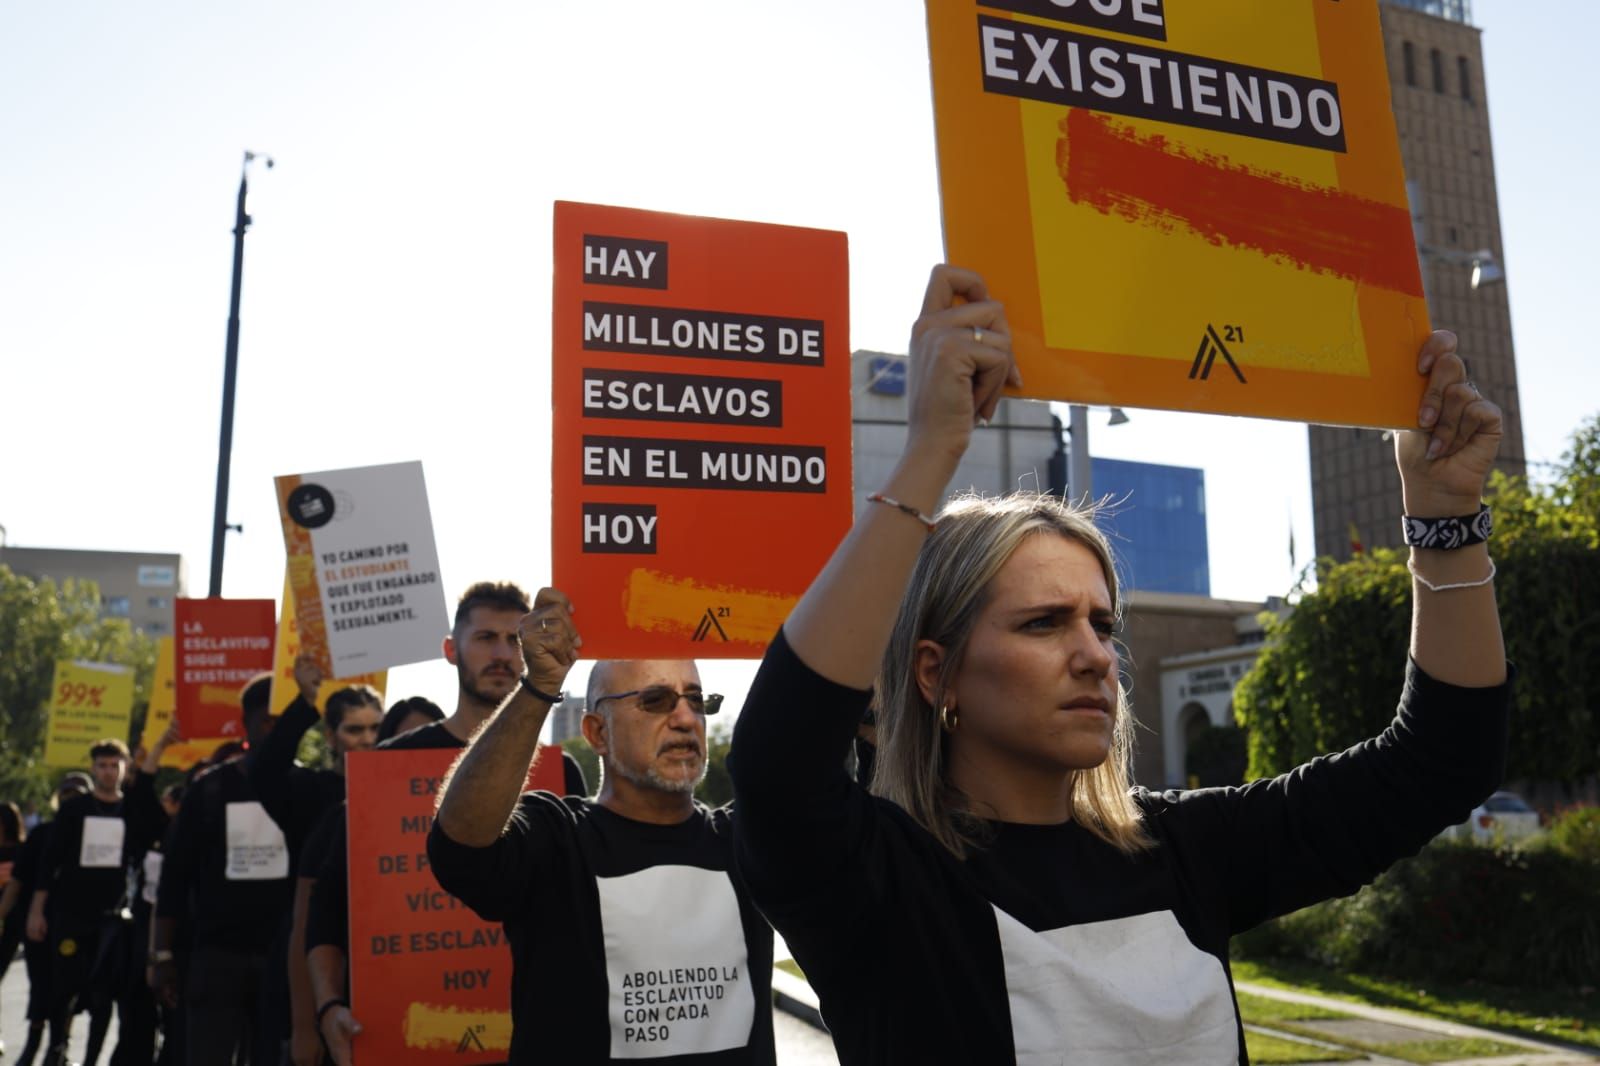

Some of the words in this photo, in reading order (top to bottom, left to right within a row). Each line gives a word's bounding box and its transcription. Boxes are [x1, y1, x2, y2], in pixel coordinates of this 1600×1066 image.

[981, 24, 1342, 137] EXISTIENDO
[584, 245, 657, 279] HAY
[584, 312, 765, 354] MILLONES
[778, 327, 820, 358] DE
[584, 379, 771, 418] ESCLAVOS
[584, 446, 630, 477] EN
[645, 449, 688, 479] EL
[702, 452, 826, 485] MUNDO
[584, 514, 658, 545] HOY
[322, 552, 337, 565] YO
[339, 545, 384, 562] CAMINO
[386, 542, 409, 556] POR
[325, 569, 337, 582] EL
[341, 558, 409, 580] ESTUDIANTE
[328, 584, 349, 598] QUE
[352, 581, 373, 594] FUE
[376, 571, 436, 592] ENGAÑADO
[330, 603, 337, 614] Y
[340, 593, 404, 614] EXPLOTADO
[183, 622, 203, 634] LA
[183, 636, 270, 650] ESCLAVITUD
[184, 653, 226, 667] SIGUE
[58, 682, 108, 708] 99%
[378, 854, 408, 875] DE
[370, 934, 402, 956] DE
[443, 968, 492, 992] HOY
[622, 966, 718, 990] ABOLIENDO
[722, 966, 739, 982] LA
[623, 984, 725, 1007] ESCLAVITUD
[623, 1007, 660, 1024] CON
[665, 1003, 710, 1022] CADA
[624, 1025, 669, 1043] PASO
